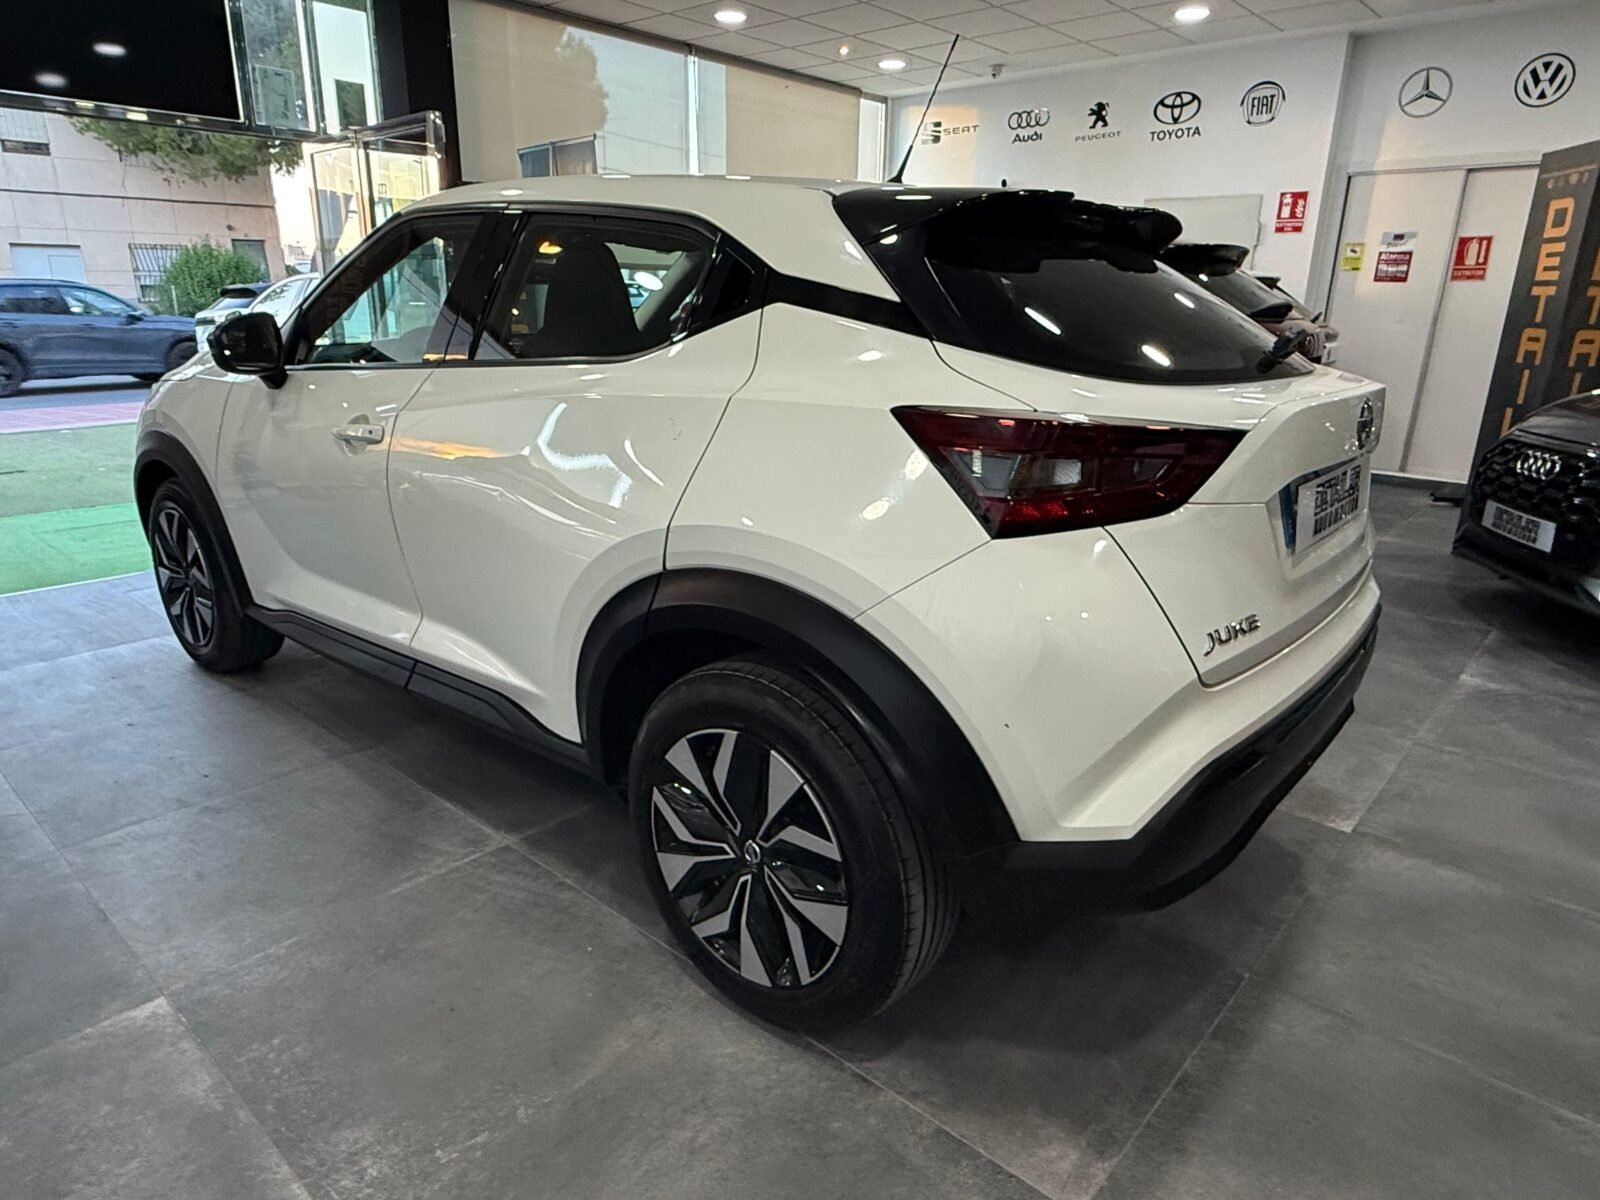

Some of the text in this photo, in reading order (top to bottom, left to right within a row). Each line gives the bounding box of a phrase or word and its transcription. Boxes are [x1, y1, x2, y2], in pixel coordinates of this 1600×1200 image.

[1250, 94, 1276, 117] FIAT
[943, 124, 979, 136] SEAT
[1075, 130, 1121, 141] PEUGEOT
[1149, 126, 1202, 142] TOYOTA
[1012, 131, 1042, 144] Audi
[1203, 613, 1261, 657] JUKE
